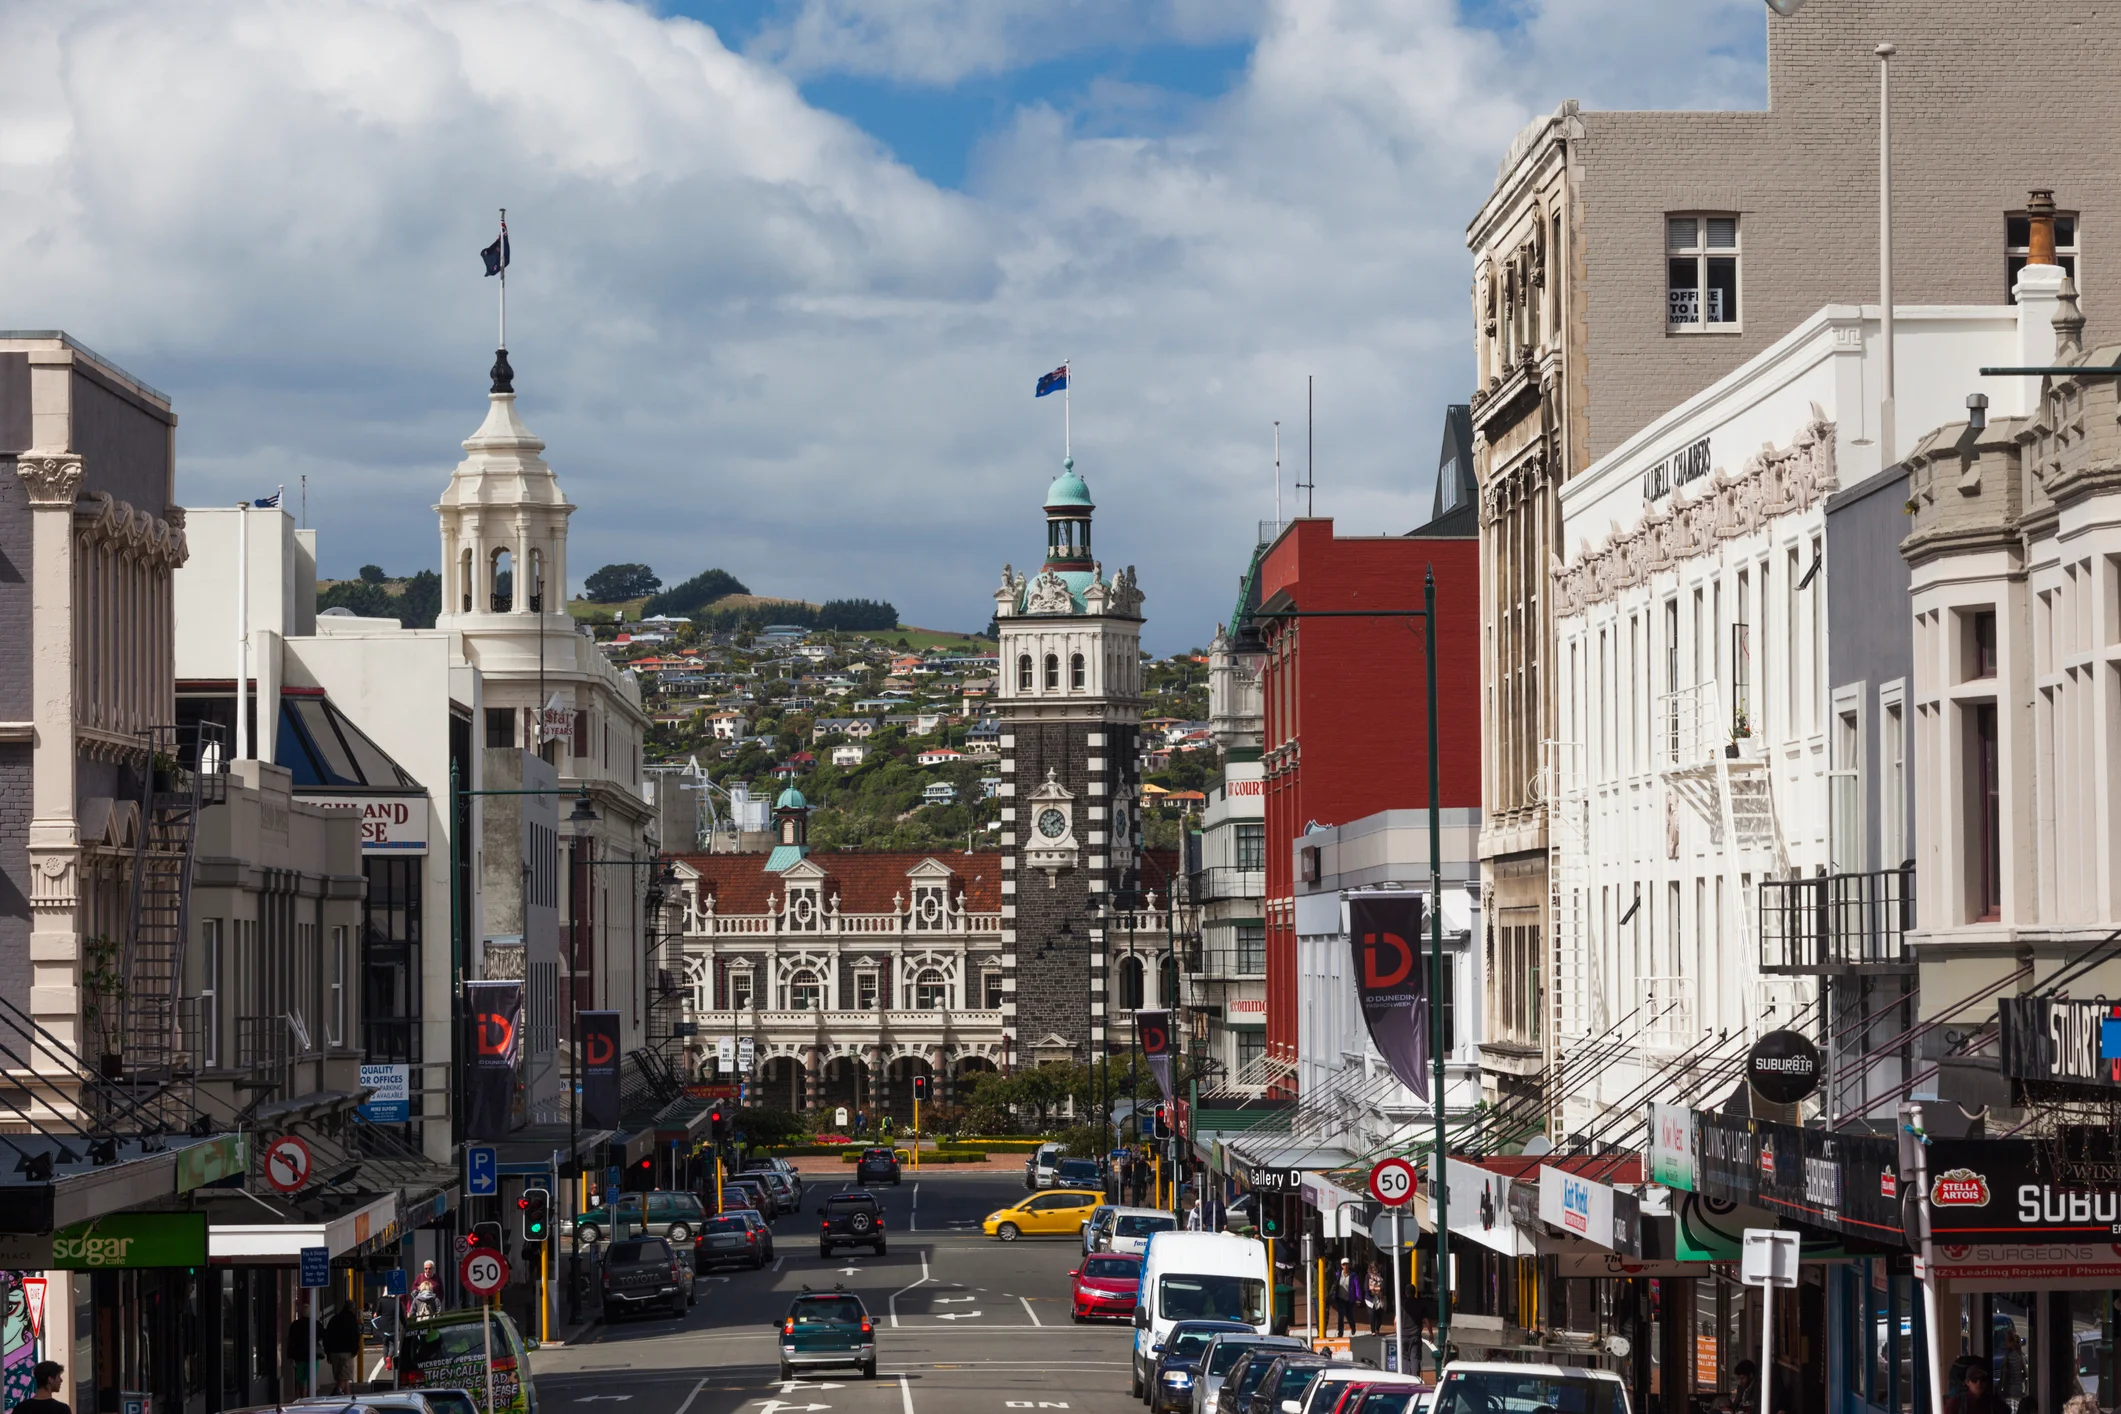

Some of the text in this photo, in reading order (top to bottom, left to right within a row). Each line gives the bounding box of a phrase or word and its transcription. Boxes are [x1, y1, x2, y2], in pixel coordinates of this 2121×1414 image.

[1670, 291, 1718, 302] OFFIE
[1670, 303, 1718, 314] TO LT
[1674, 436, 1711, 488] CHAMBERS
[551, 727, 573, 735] YEARS
[1375, 994, 1415, 1002] DUNEDIN
[2050, 1002, 2099, 1080] STUART
[361, 1066, 394, 1075] QUALITY
[1755, 1057, 1813, 1072] SUBURBIA
[373, 1075, 403, 1084] OFFICES
[1704, 1126, 1725, 1160] LIVING
[1732, 1130, 1752, 1165] LIGHT
[475, 1153, 489, 1170] P
[1250, 1168, 1284, 1188] Gallery
[1382, 1173, 1408, 1192] 50
[1942, 1183, 1979, 1191] STELLA
[1942, 1191, 1979, 1200] ARTOIS
[53, 1237, 134, 1265] sugar
[1976, 1247, 2093, 1261] SURGEONS
[105, 1256, 125, 1265] cafe
[472, 1263, 498, 1282] 50
[619, 1273, 661, 1285] TOYOTA
[1959, 1268, 2009, 1277] Leading
[2012, 1267, 2064, 1276] Repairer
[425, 1368, 453, 1380] THEY
[455, 1364, 479, 1377] CALL
[481, 1384, 518, 1399] DSEASE
